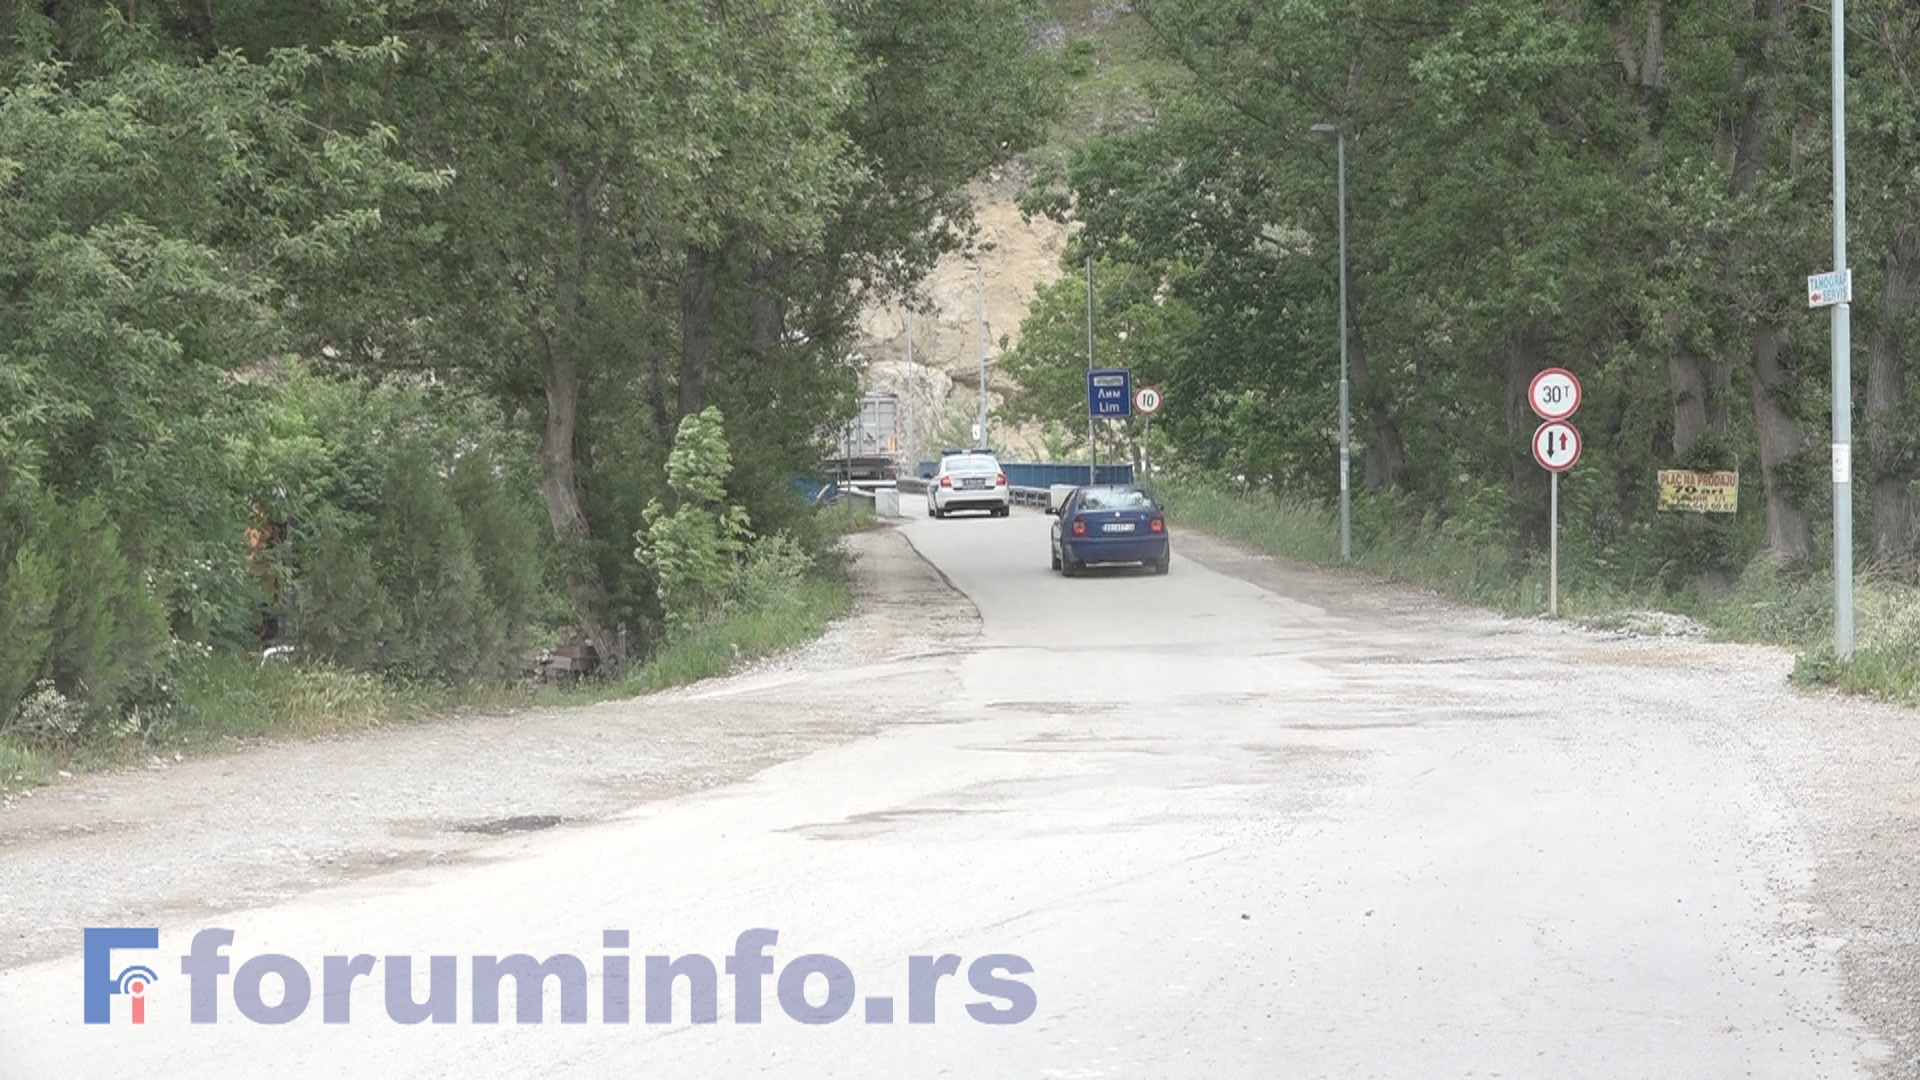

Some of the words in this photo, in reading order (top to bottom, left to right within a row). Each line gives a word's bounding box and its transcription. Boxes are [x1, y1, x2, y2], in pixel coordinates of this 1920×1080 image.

[1823, 287, 1847, 302] SERVIS
[1098, 388, 1121, 399] Лим
[1142, 393, 1154, 407] 10
[1099, 401, 1120, 413] Lim
[1684, 474, 1695, 485] NA
[1698, 473, 1736, 487] PRODAJU
[1673, 486, 1697, 494] 70
[1701, 487, 1723, 495] ari
